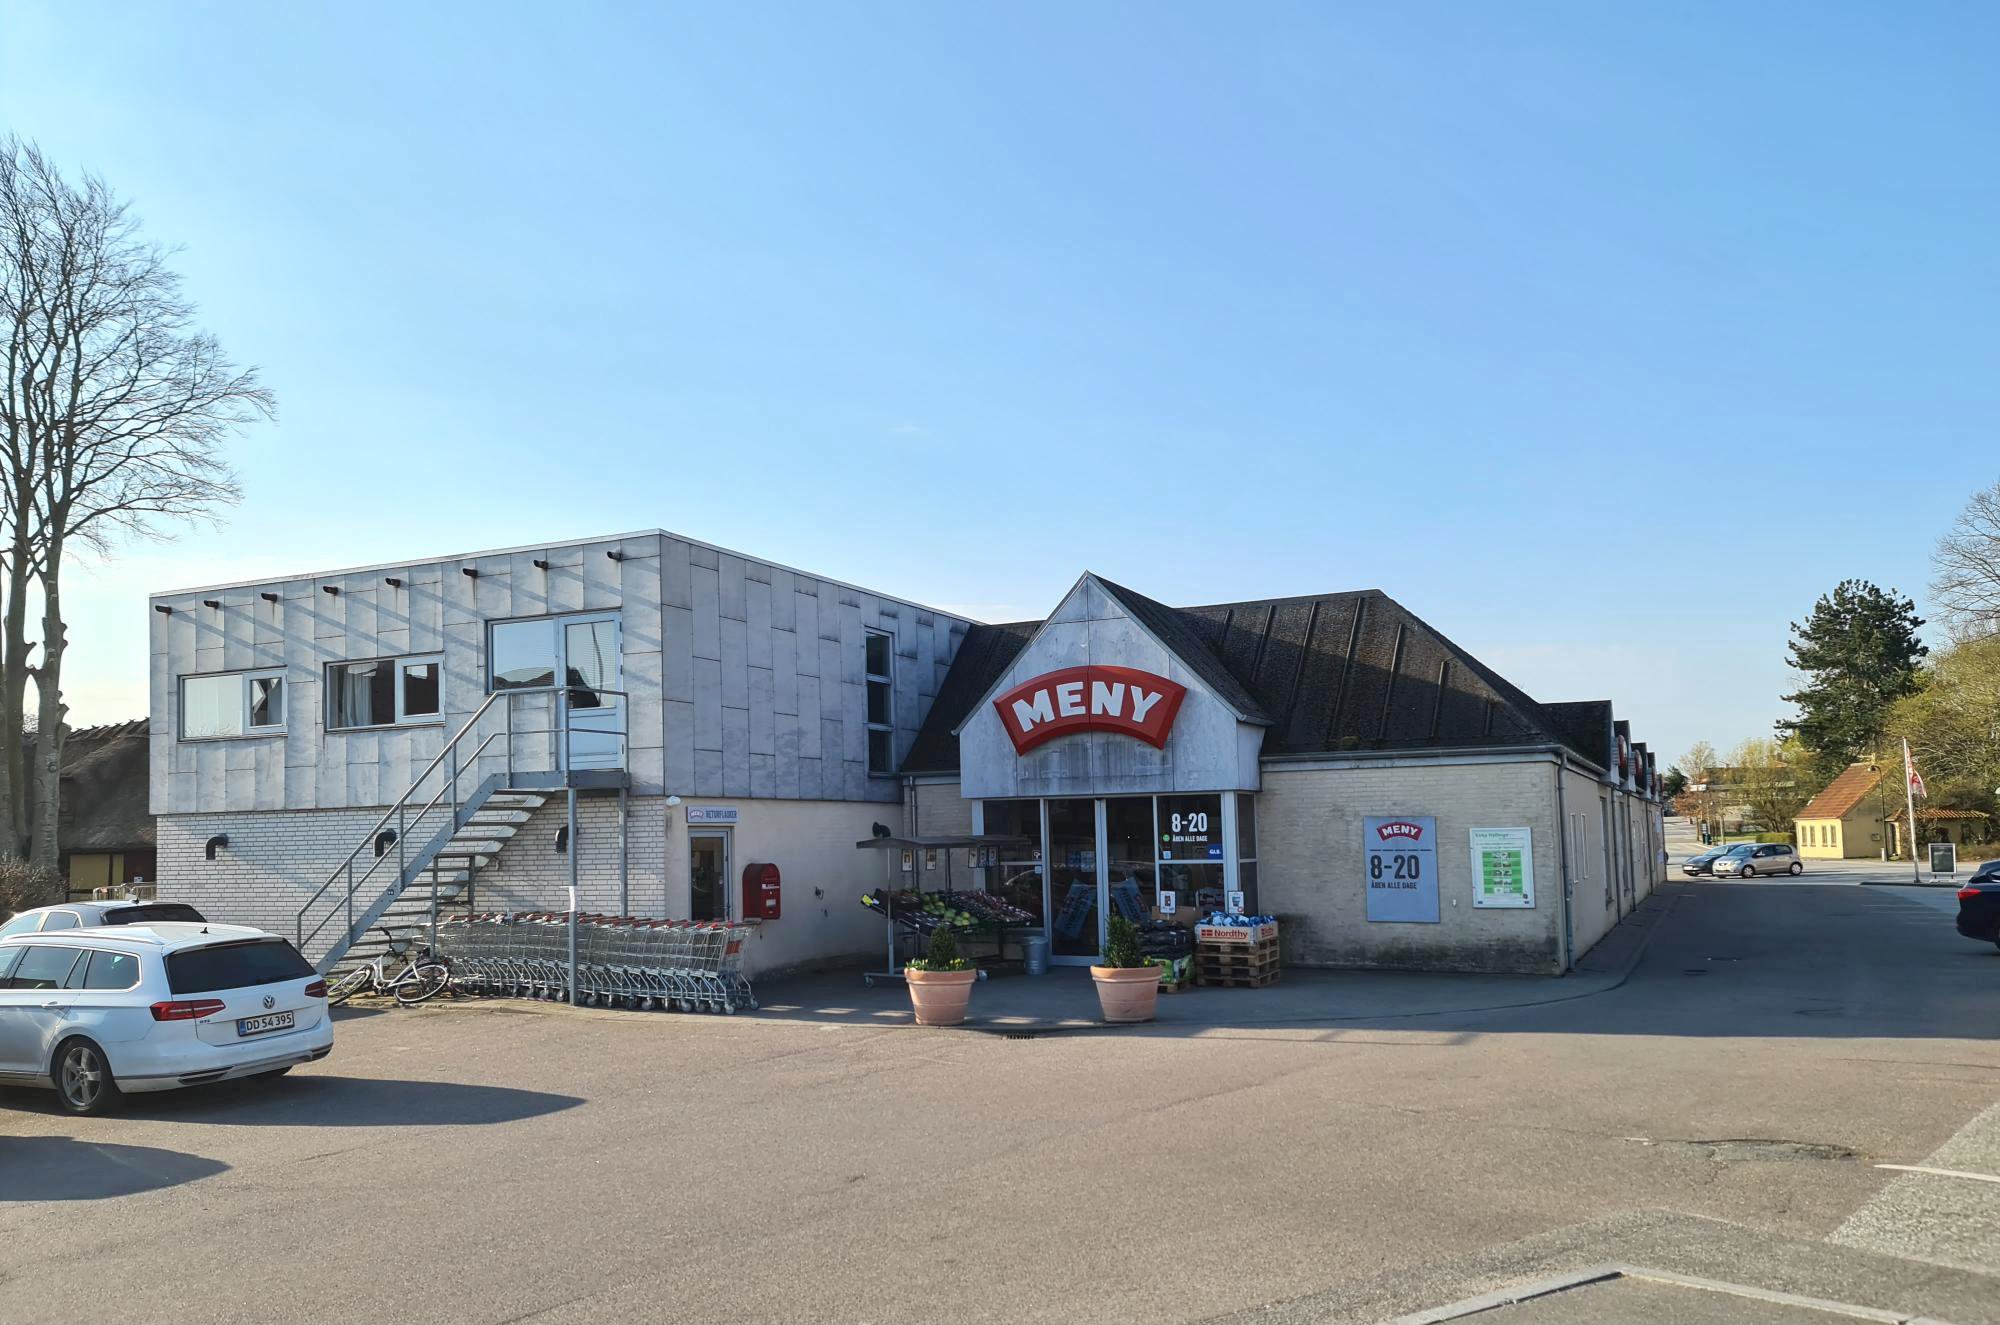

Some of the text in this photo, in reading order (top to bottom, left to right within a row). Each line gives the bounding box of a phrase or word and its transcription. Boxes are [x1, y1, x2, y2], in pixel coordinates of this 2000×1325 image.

[1011, 681, 1163, 733] MENY
[1171, 812, 1208, 832] 8-20
[1382, 825, 1418, 836] MENY
[1370, 854, 1420, 880] 8-20
[1371, 881, 1417, 889] ÅBEN ALLE DAGE
[1214, 929, 1248, 939] Nordthy
[246, 1020, 260, 1031] DD
[262, 1017, 274, 1028] 54
[275, 1013, 292, 1026] 395
